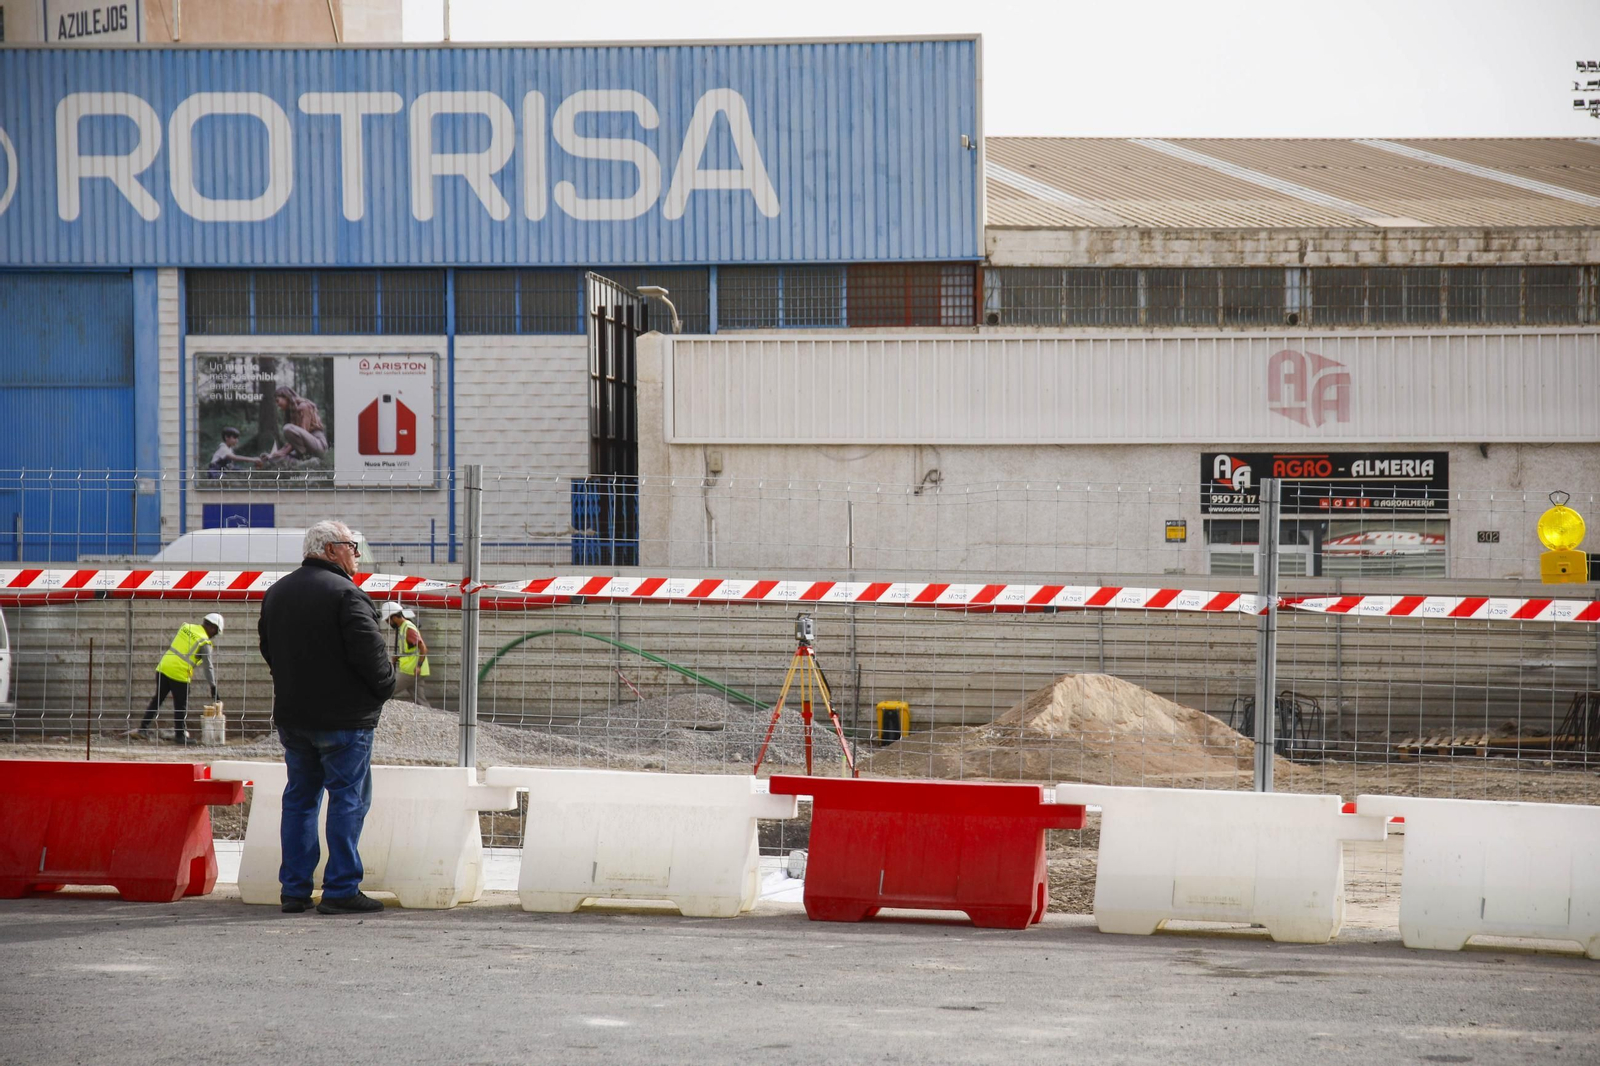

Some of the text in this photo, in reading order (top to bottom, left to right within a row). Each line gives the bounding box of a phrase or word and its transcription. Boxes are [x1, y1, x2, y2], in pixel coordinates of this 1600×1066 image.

[58, 4, 128, 40] AZULEJOS
[56, 88, 781, 222] ROTRISA
[373, 362, 427, 370] ARISTON
[235, 391, 264, 403] hogar
[1273, 460, 1332, 477] AGRO
[1351, 459, 1435, 478] ALMERIA
[1211, 494, 1257, 504] 950 22 17
[1478, 531, 1500, 543] 302
